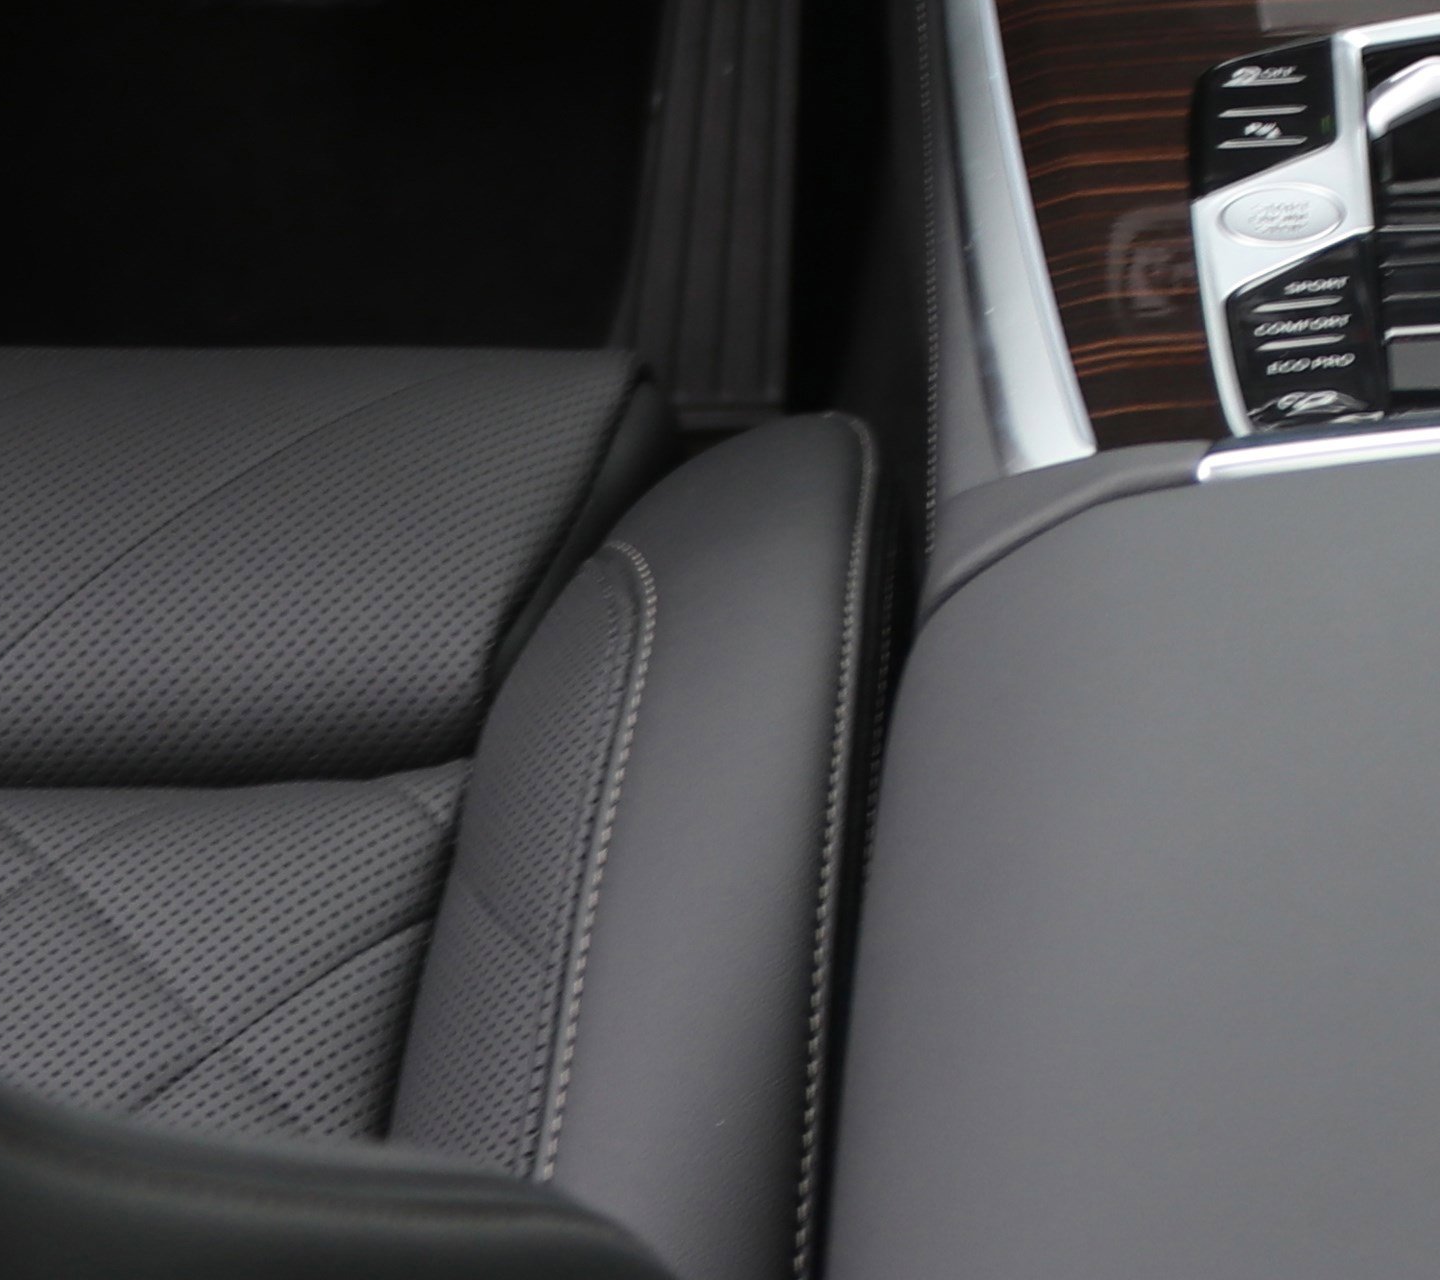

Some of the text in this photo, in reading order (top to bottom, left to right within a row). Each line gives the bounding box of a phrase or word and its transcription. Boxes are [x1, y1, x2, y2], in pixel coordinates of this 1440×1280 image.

[1283, 275, 1351, 296] SPORT
[1253, 313, 1353, 337] COMFORT
[1266, 352, 1356, 376] ECO PRO
